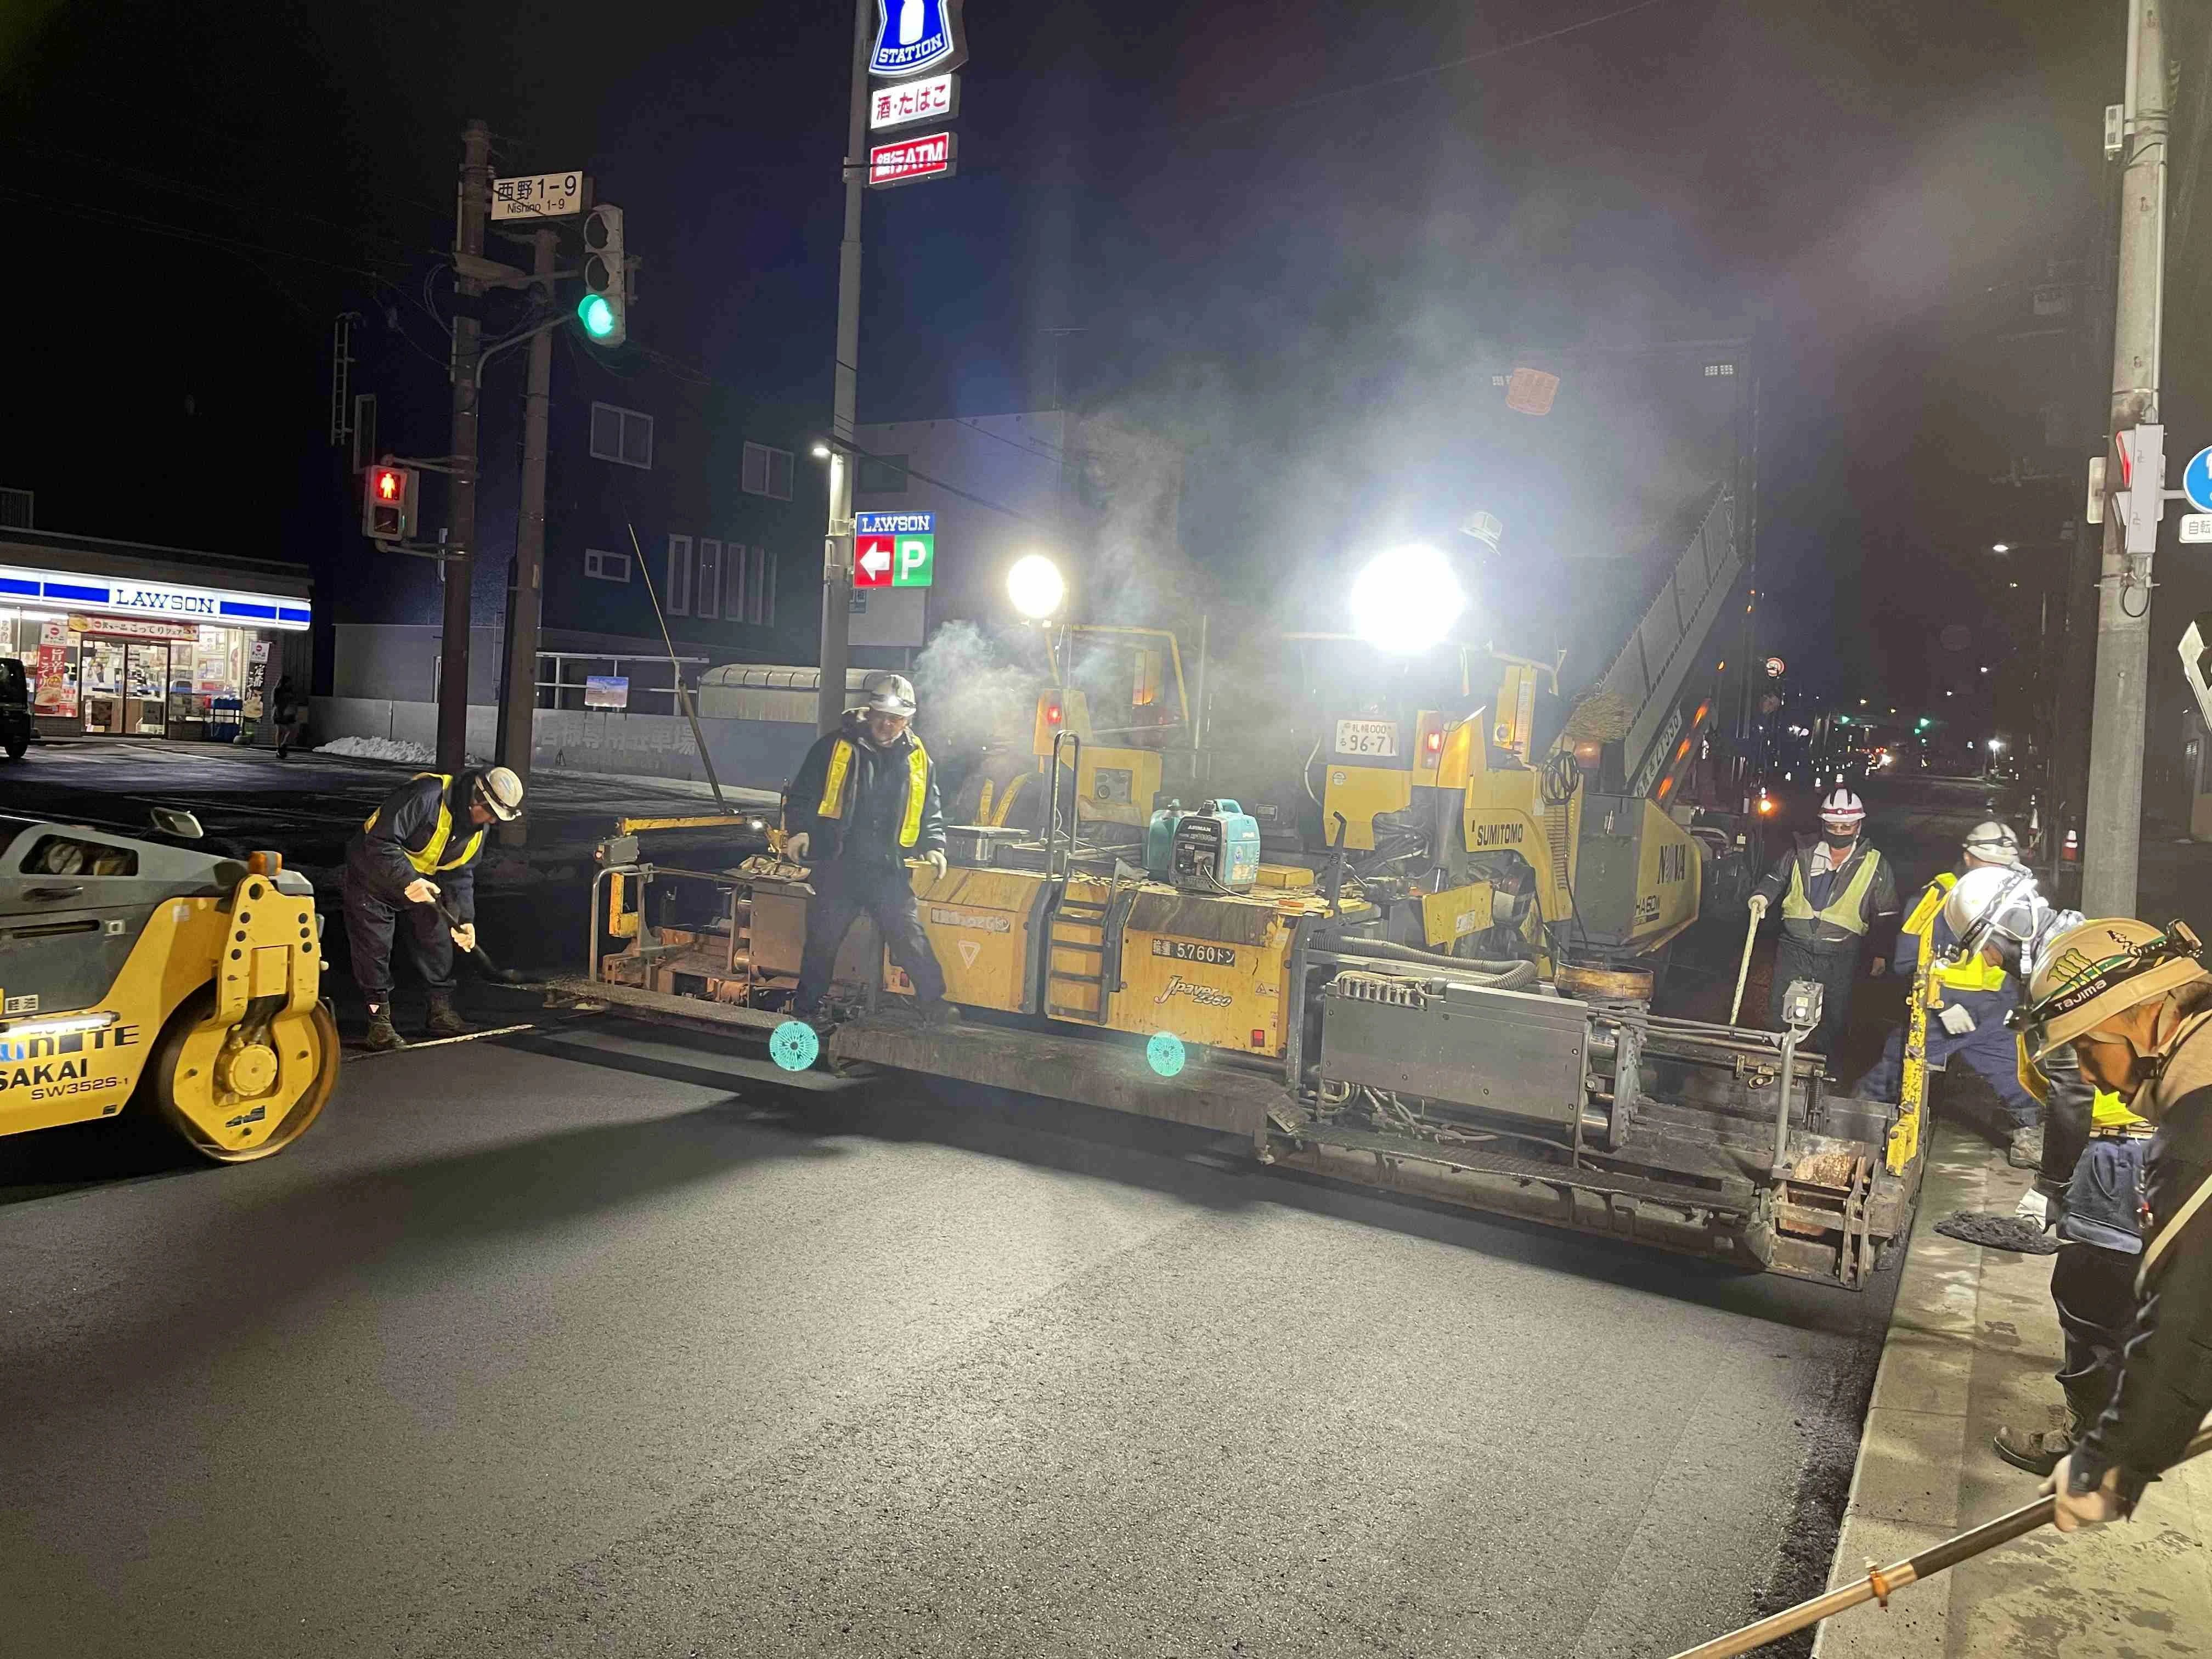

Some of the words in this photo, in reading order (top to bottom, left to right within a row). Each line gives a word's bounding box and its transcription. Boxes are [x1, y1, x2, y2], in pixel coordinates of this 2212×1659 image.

[878, 33, 944, 63] STATION
[876, 84, 946, 120] 酒・たばこ
[498, 175, 577, 202] 西野1-9
[546, 198, 565, 211] 1-9
[861, 515, 930, 532] LAWSON
[901, 540, 927, 580] P
[116, 589, 215, 613] LAWSON
[1349, 735, 1393, 754] 96-71
[1476, 823, 1523, 846] SUMITOMO
[31, 1076, 128, 1100] SW352S-1
